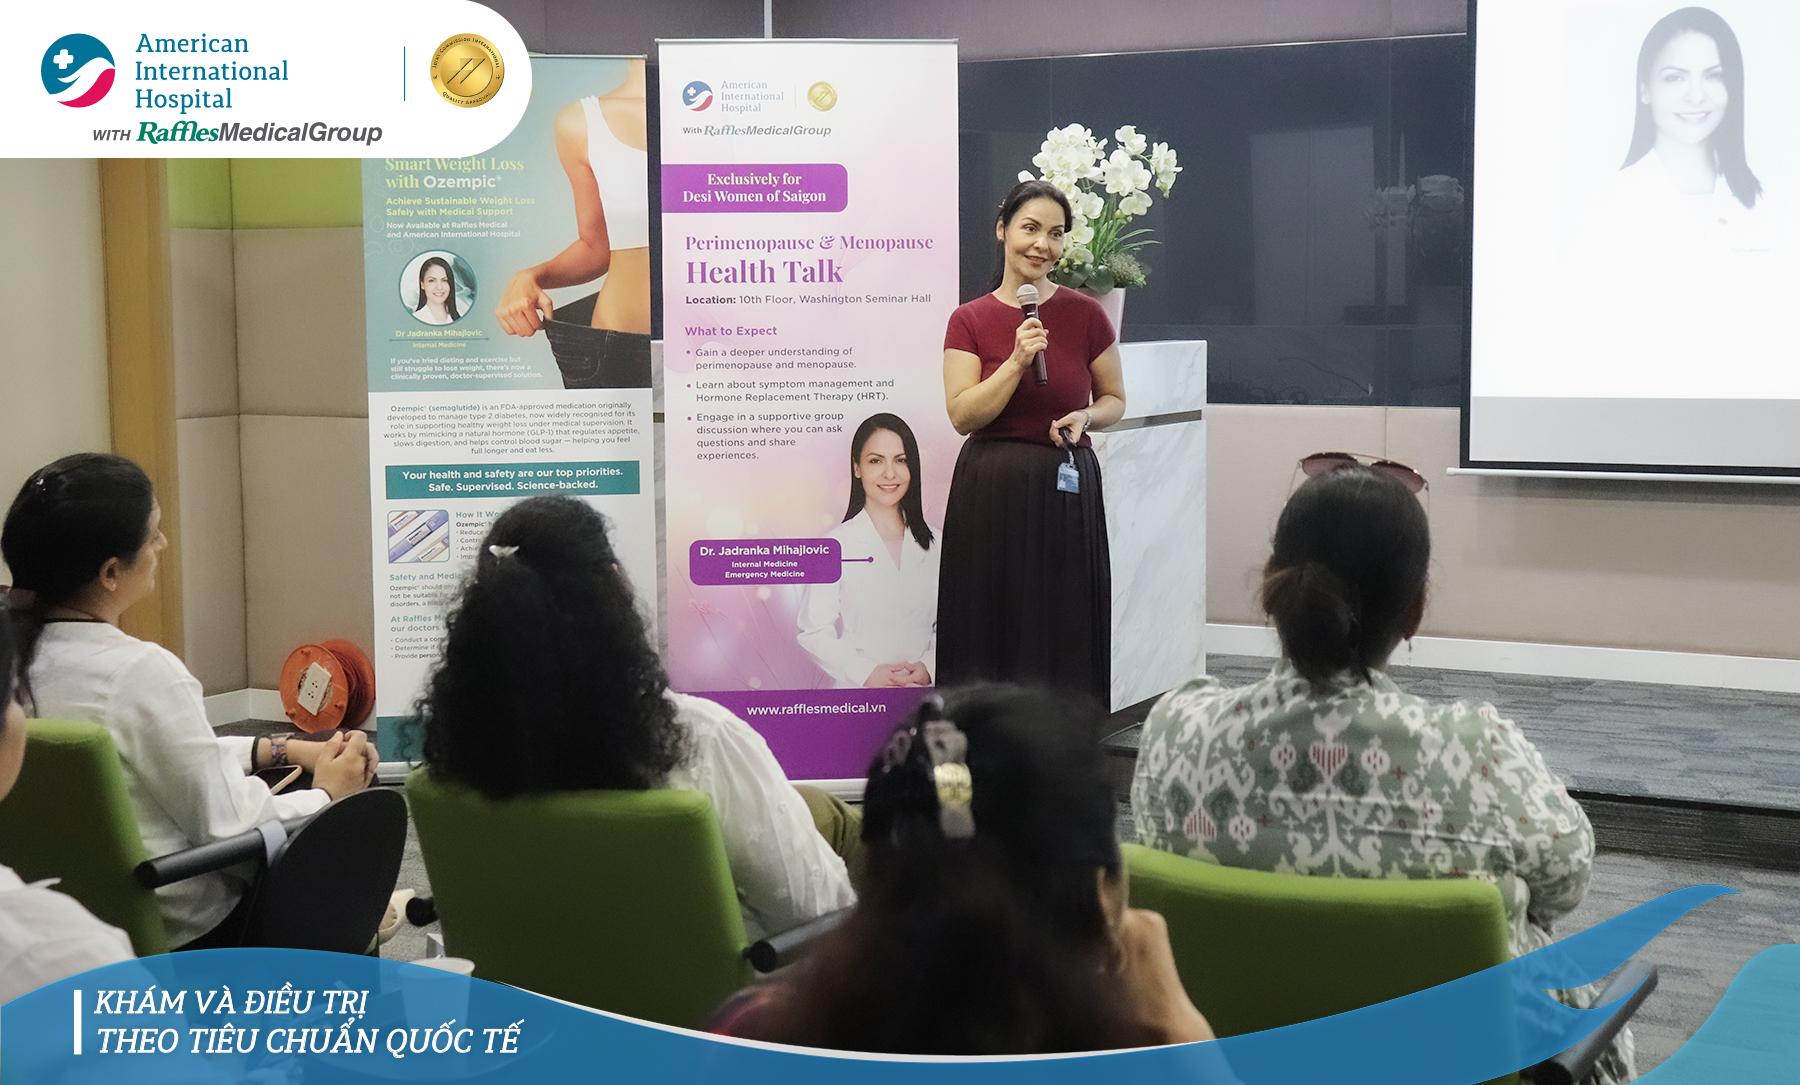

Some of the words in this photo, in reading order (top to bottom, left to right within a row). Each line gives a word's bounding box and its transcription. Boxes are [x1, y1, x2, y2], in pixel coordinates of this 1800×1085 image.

[720, 80, 768, 90] American
[722, 92, 784, 100] International
[722, 103, 760, 114] Hospital
[704, 125, 831, 136] RafflesMedicalGroup
[386, 157, 433, 170] Smart
[433, 157, 486, 172] Weight
[492, 158, 524, 170] Loss
[708, 173, 780, 187] Exclusively
[783, 173, 802, 185] for
[386, 196, 422, 206] Achieve
[424, 196, 478, 206] Sustainable
[480, 196, 512, 205] Weight
[684, 190, 712, 202] Desi
[714, 191, 763, 202] Women
[767, 190, 781, 202] of
[783, 190, 826, 204] Saigon
[386, 208, 416, 216] Safely
[416, 208, 438, 216] with
[440, 208, 476, 216] Medical
[476, 208, 514, 216] Support
[386, 222, 404, 230] Now
[386, 230, 402, 238] and
[687, 236, 814, 252] Perimenopause
[820, 236, 835, 249] &
[840, 236, 933, 252] Menopause
[688, 260, 775, 283] Health
[783, 259, 843, 283] Talk
[686, 296, 736, 304] Location:
[740, 296, 762, 304] 10th
[766, 296, 796, 304] Floor,
[799, 295, 862, 304] Washington
[866, 294, 908, 304] Seminar
[912, 294, 930, 302] Hall
[444, 330, 484, 338] Mihajlovic
[684, 326, 716, 336] What
[720, 326, 732, 336] to
[736, 326, 776, 336] Expect
[696, 348, 718, 356] Gain
[730, 348, 766, 356] deeper
[768, 348, 840, 356] understanding
[842, 346, 852, 356] of
[696, 362, 772, 370] perimenopause
[776, 360, 794, 368] and
[796, 362, 856, 370] menopause.
[696, 382, 724, 390] Learn
[726, 380, 756, 388] about
[760, 380, 806, 390] symptom
[808, 380, 872, 390] management
[876, 378, 894, 388] and
[746, 394, 810, 402] Replacement
[814, 392, 854, 402] Therapy
[856, 392, 888, 400] (HRT).
[428, 404, 480, 412] (semaglutide)
[598, 402, 632, 410] originally
[696, 414, 734, 422] Engage
[738, 412, 746, 420] in
[758, 412, 812, 422] supportive
[814, 414, 844, 422] group
[408, 432, 418, 440] by
[418, 430, 456, 438] mimicking
[526, 428, 554, 436] (GLP-1)
[696, 426, 748, 434] discussion
[784, 426, 802, 434] you
[826, 424, 842, 432] ask
[696, 440, 744, 448] questions
[748, 438, 766, 446] and
[768, 438, 796, 446] share
[696, 452, 760, 460] experiences.
[402, 472, 426, 480] Your
[430, 470, 460, 480] health
[464, 470, 482, 478] and
[485, 470, 515, 479] safety
[536, 470, 554, 478] our
[556, 468, 574, 478] top
[576, 468, 623, 477] priorities.
[428, 482, 454, 492] Safe.
[456, 482, 514, 492] Supervised.
[517, 480, 598, 489] Science-backed.
[700, 547, 715, 556] Dr.
[719, 546, 769, 555] Jadranka
[773, 545, 829, 556] Mihajlovic
[402, 614, 432, 622] Raffles
[747, 703, 886, 715] www.rafflesmedical.vn
